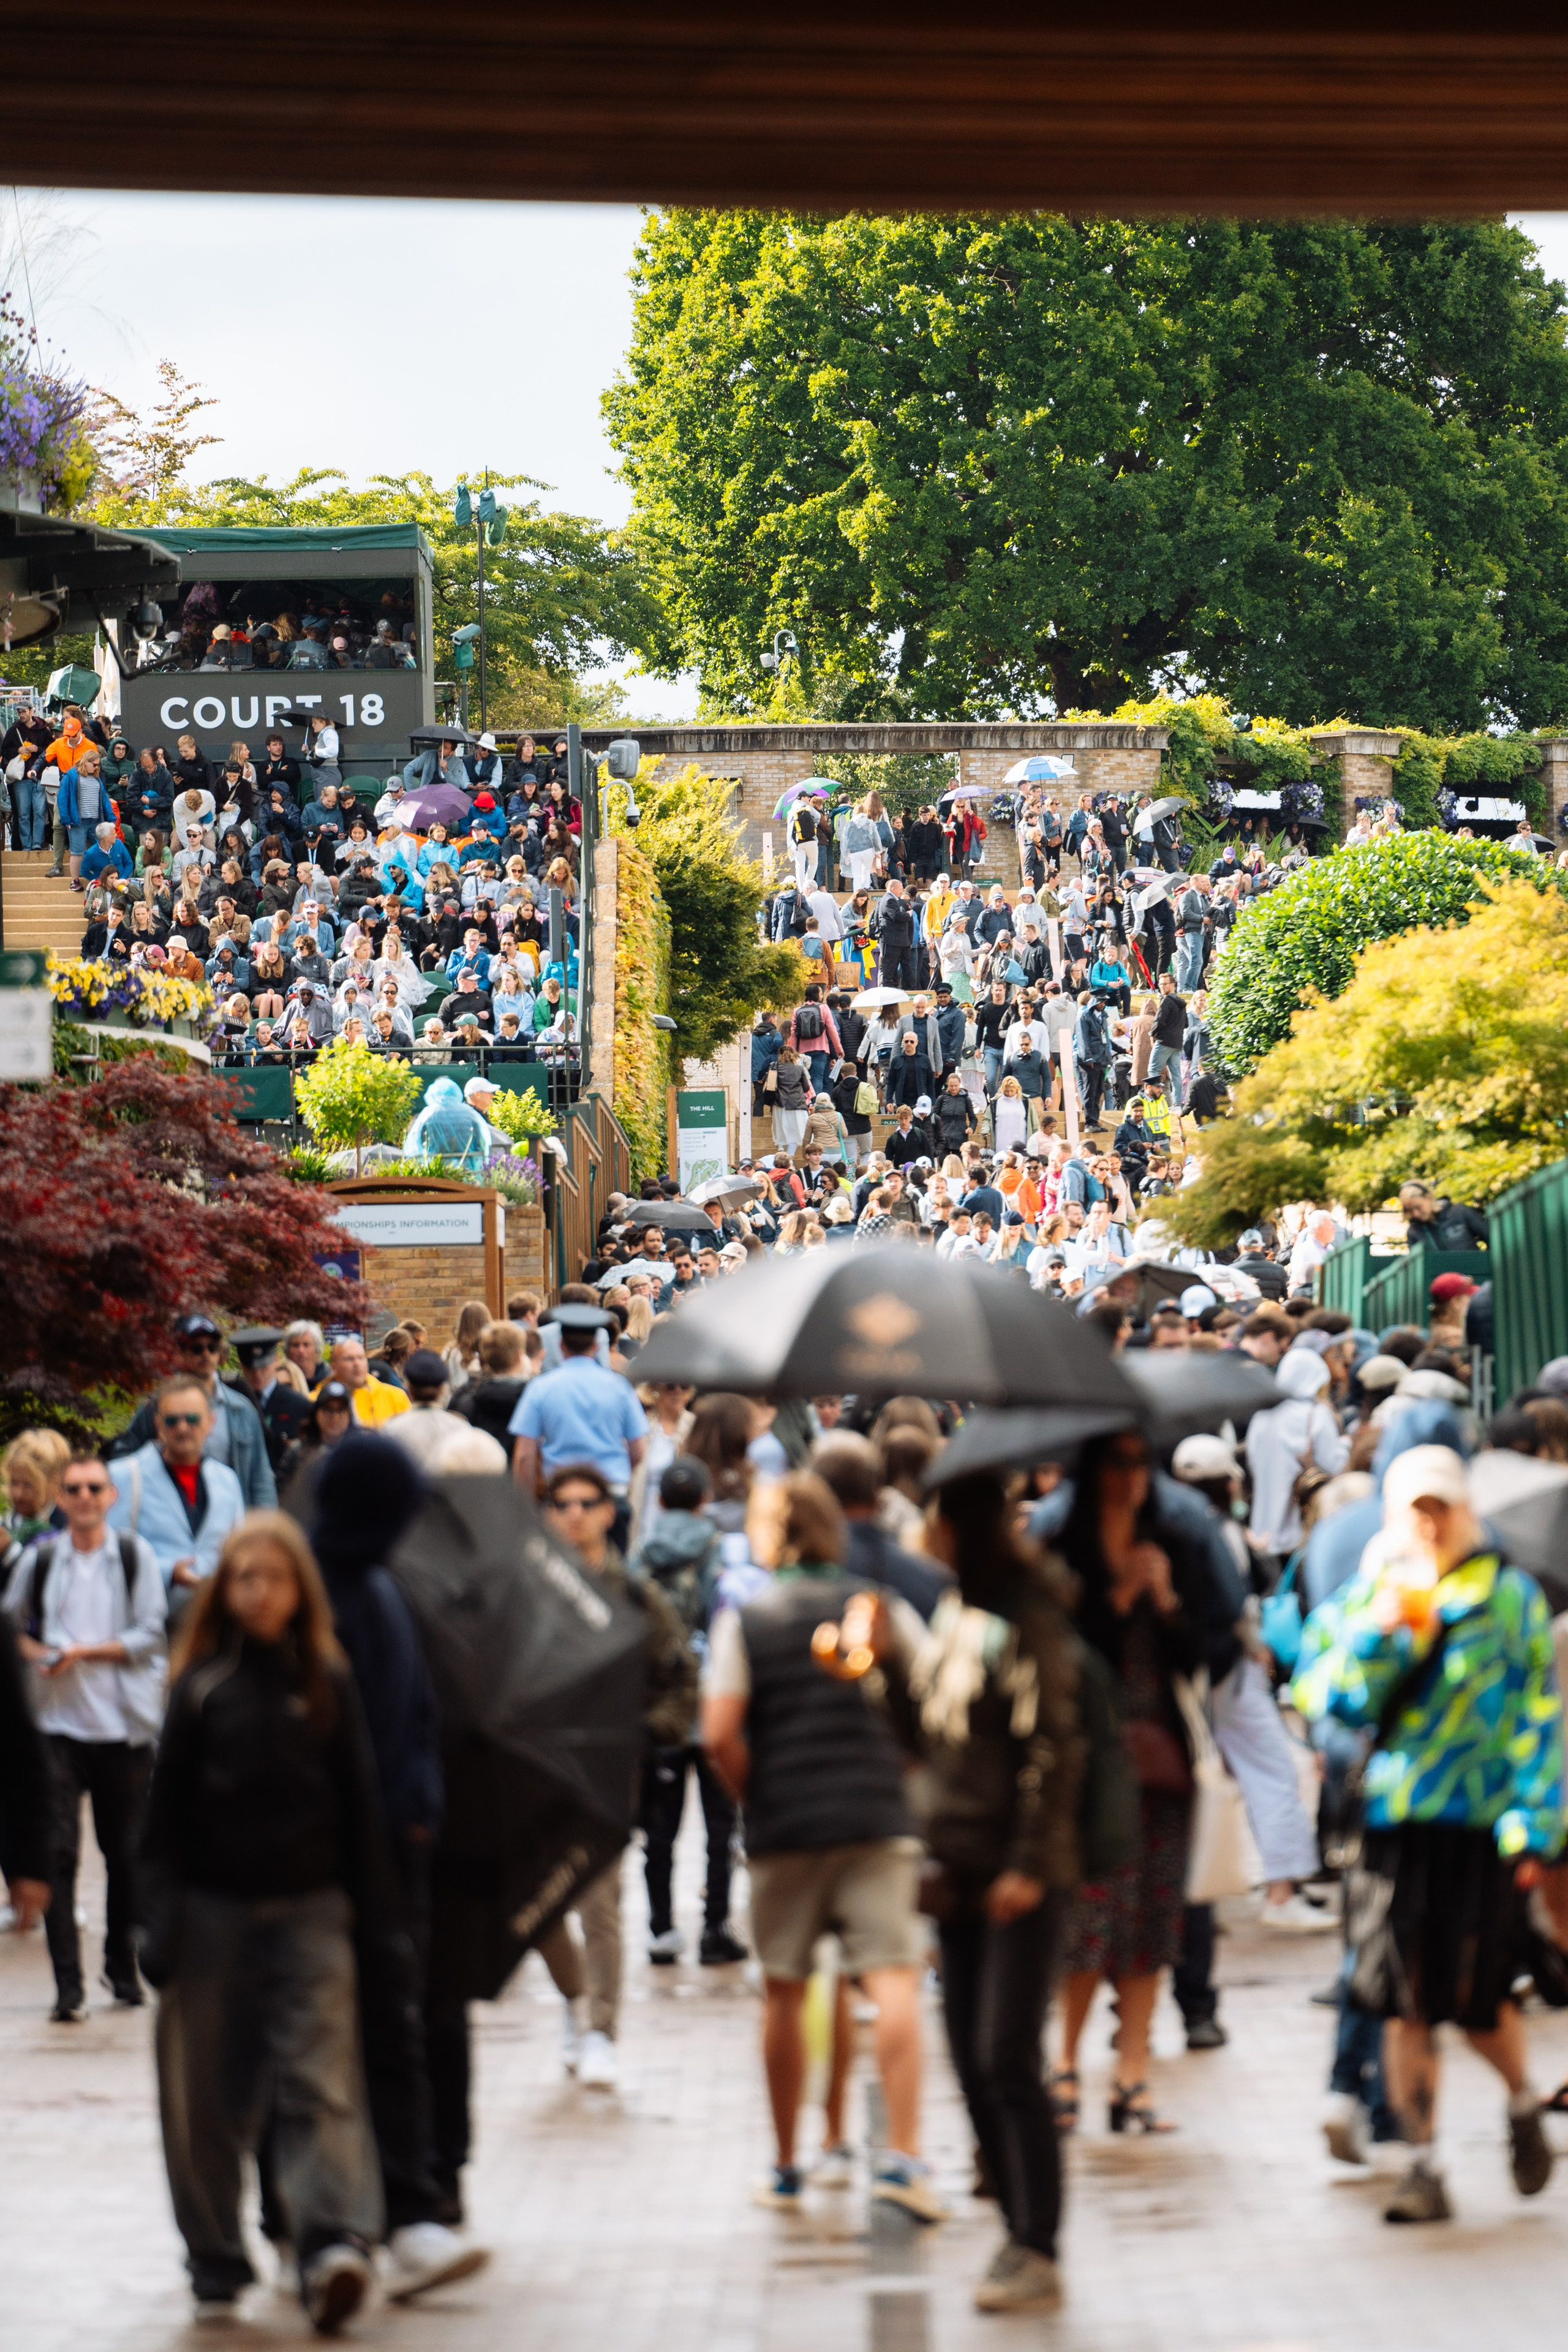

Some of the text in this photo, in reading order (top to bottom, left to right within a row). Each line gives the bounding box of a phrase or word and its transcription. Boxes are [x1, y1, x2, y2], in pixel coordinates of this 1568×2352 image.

[160, 693, 385, 729] COURT 18
[337, 1219, 469, 1229] MPIONSHIPS INFORMATION
